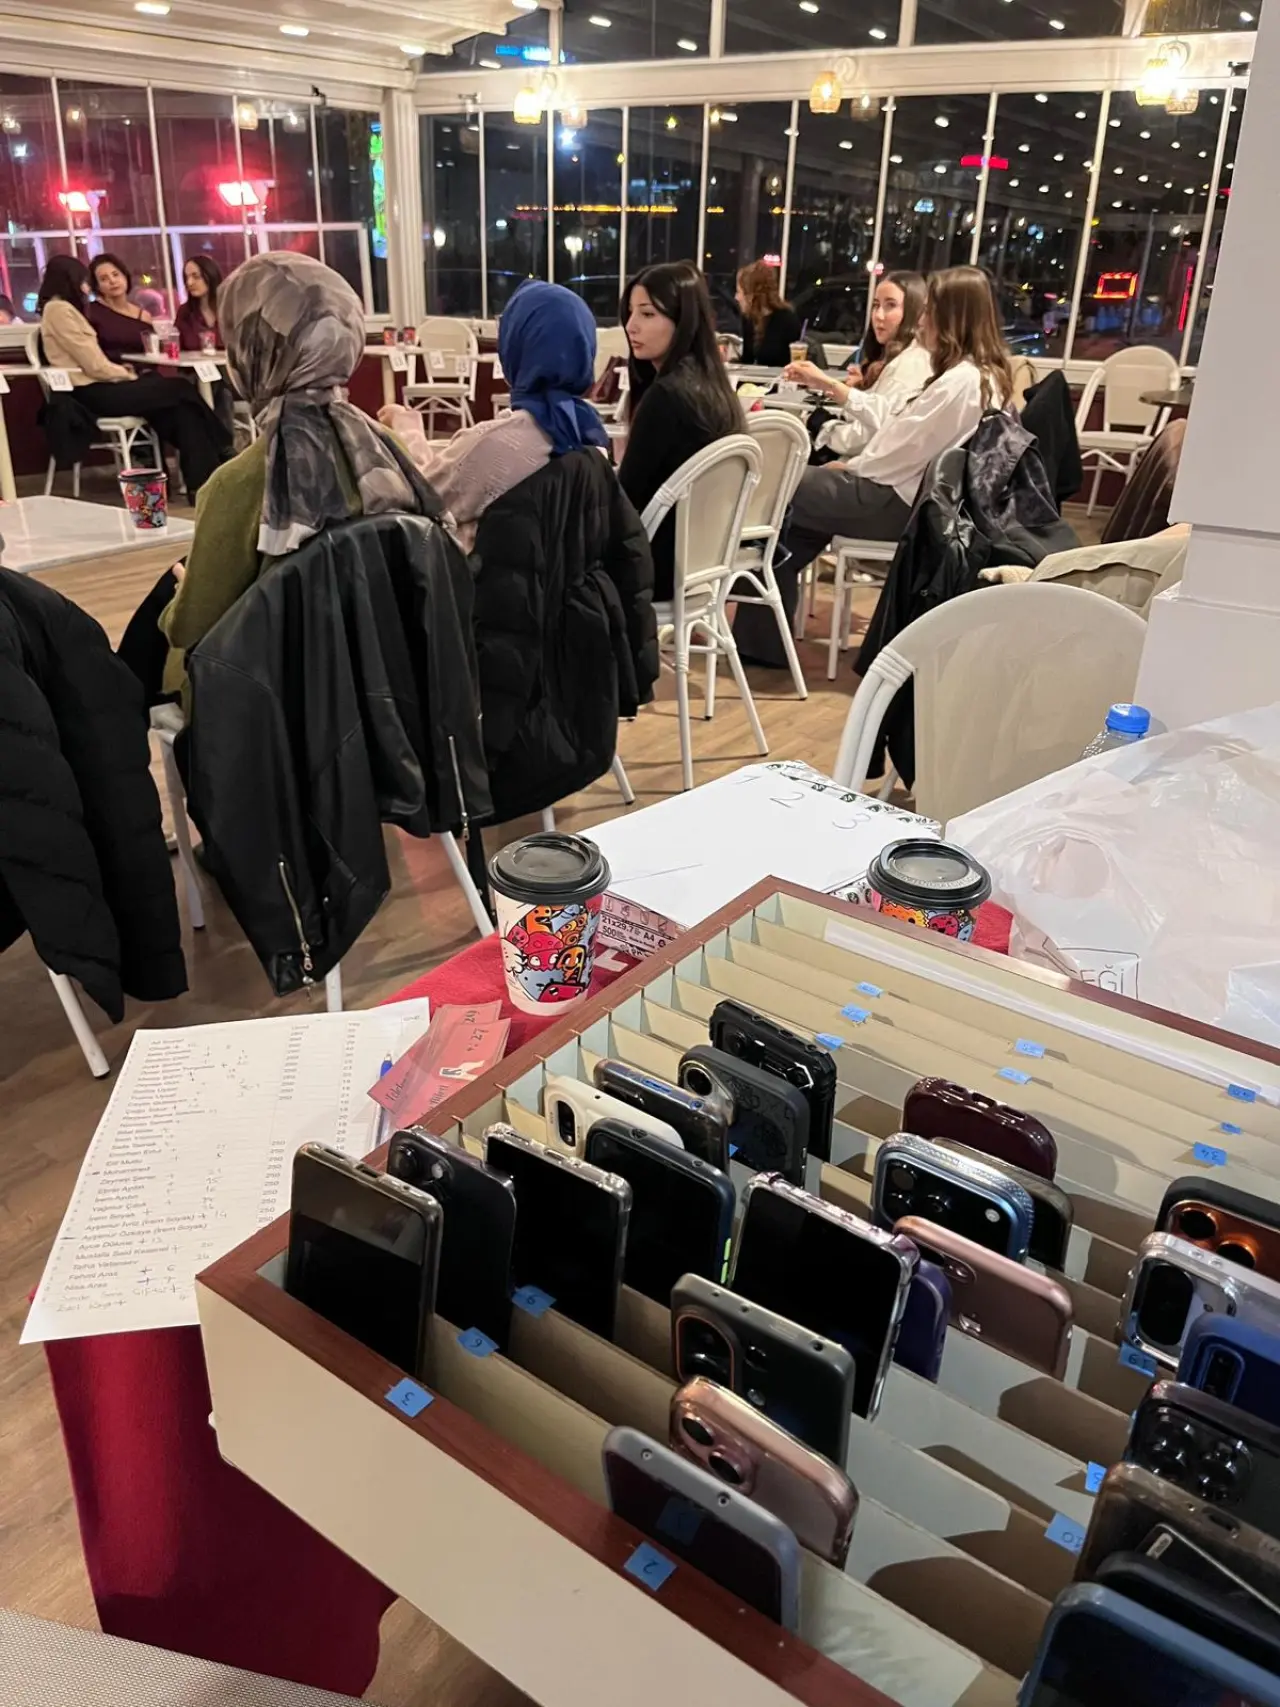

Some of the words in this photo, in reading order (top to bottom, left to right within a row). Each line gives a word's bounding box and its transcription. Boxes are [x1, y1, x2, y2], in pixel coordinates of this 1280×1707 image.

[602, 915, 633, 933] 21x29.7
[644, 932, 655, 941] A4
[603, 925, 617, 936] 500
[1199, 1146, 1220, 1161] 34
[1128, 1352, 1150, 1369] 19
[402, 1391, 415, 1406] 3
[642, 1559, 660, 1575] 2
